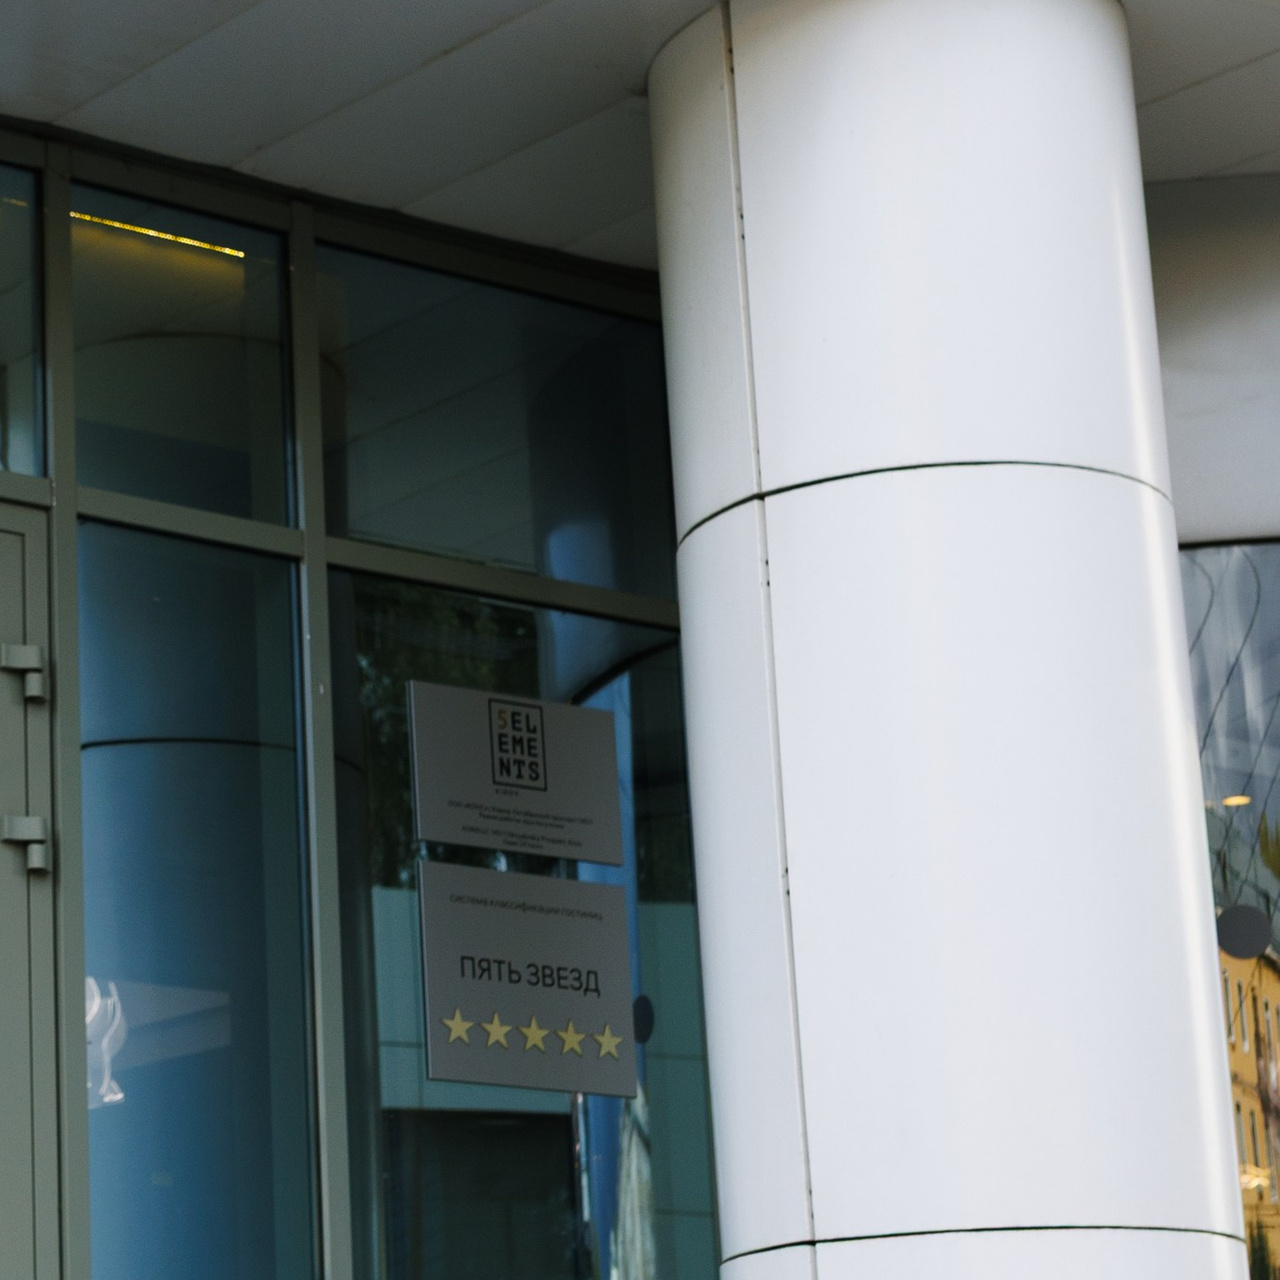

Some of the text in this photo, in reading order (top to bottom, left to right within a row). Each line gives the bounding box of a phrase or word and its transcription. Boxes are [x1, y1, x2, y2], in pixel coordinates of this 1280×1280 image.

[498, 709, 537, 734] 5EL
[498, 733, 538, 758] EME
[499, 757, 540, 782] NTS
[460, 955, 601, 999] ПЯТЬ ЗВЕЗД
